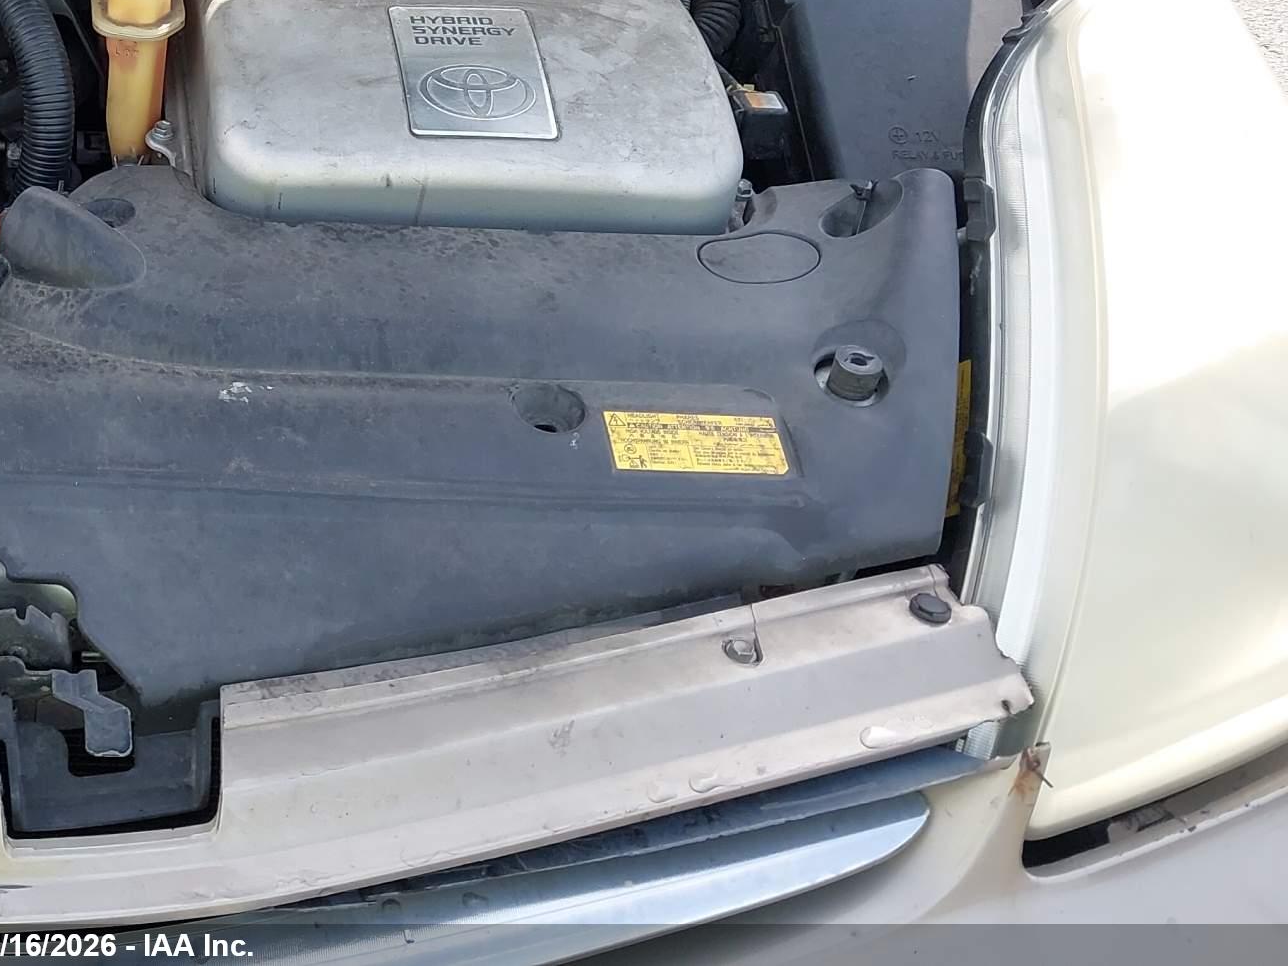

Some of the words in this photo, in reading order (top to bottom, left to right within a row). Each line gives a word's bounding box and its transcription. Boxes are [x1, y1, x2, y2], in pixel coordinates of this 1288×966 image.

[409, 16, 493, 26] HYBRID
[412, 26, 515, 36] SYNERGY
[415, 36, 483, 46] DRIVE
[891, 149, 929, 161] RELAY
